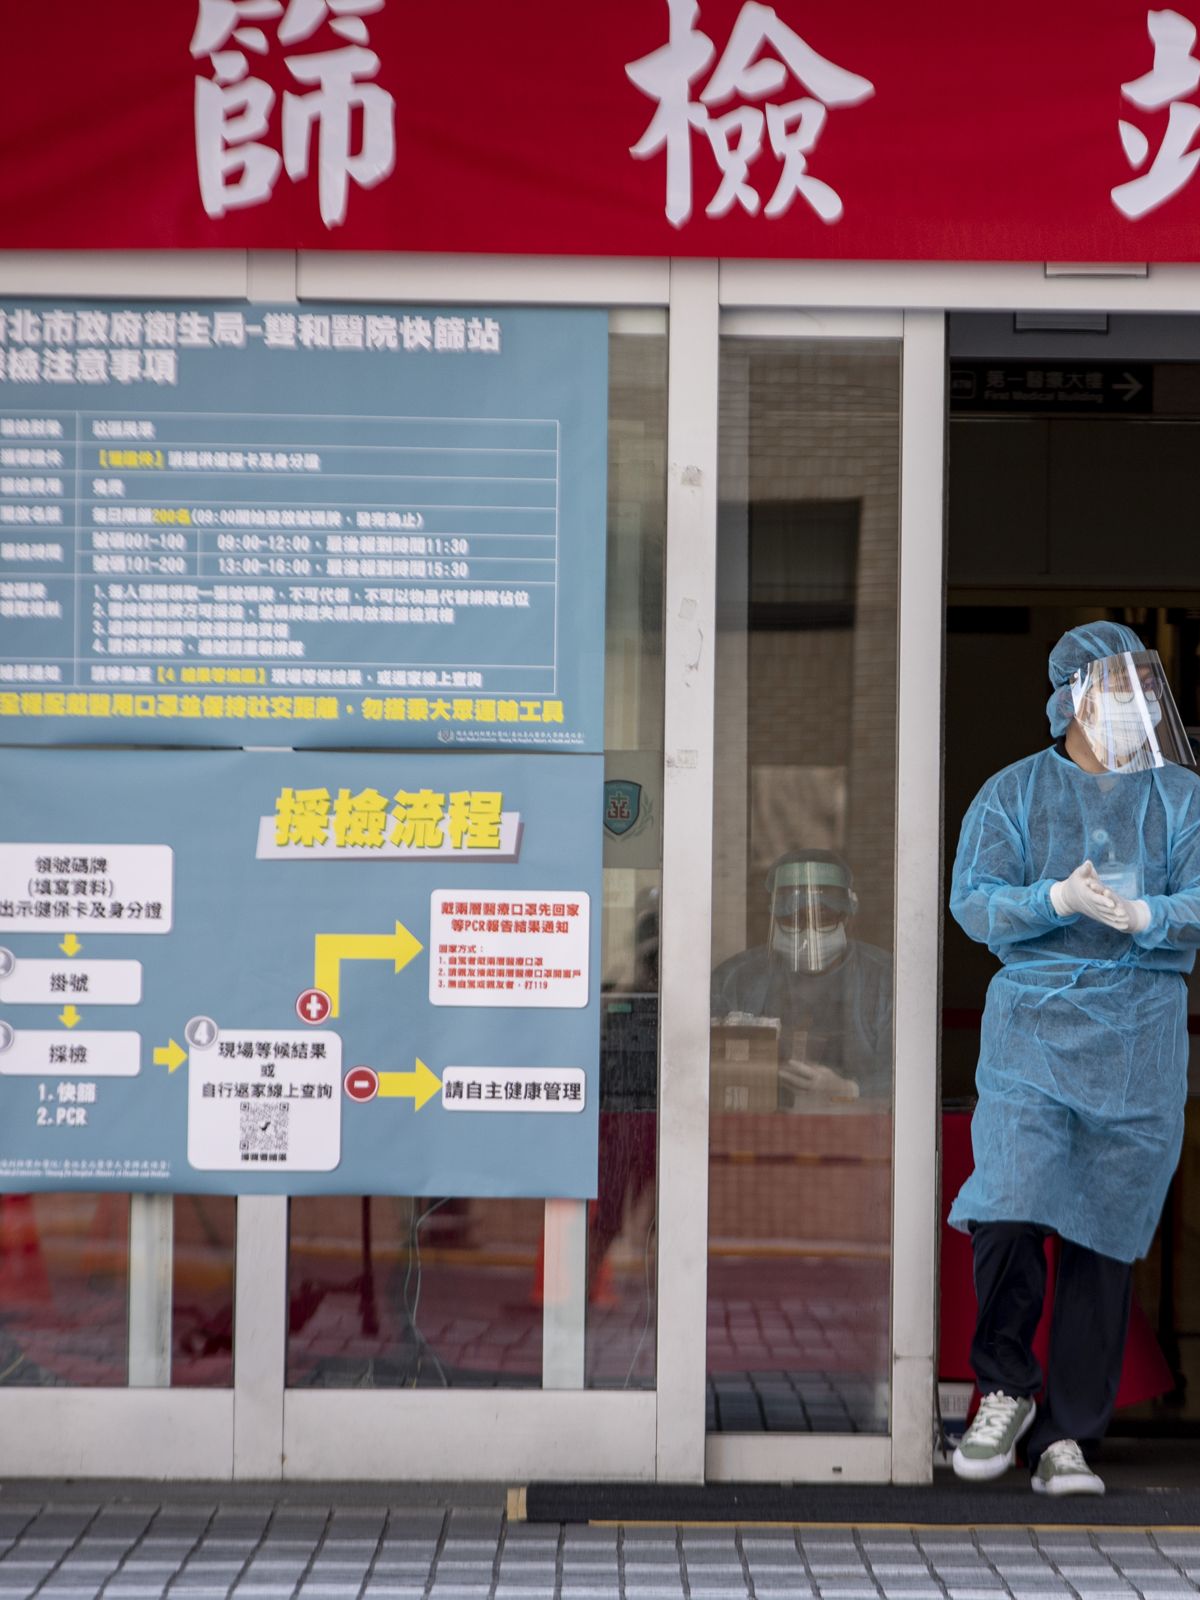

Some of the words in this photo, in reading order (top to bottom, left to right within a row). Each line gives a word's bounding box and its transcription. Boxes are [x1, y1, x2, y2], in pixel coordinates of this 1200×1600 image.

[0, 309, 500, 352] 北市政府衛生局-雙和醫院快篩站
[0, 348, 178, 385] 檢注意事項
[274, 787, 503, 849] 採檢流程
[35, 856, 107, 874] 領號碼牌
[28, 878, 114, 897] (填寫資料)
[50, 974, 89, 992] 掛號
[49, 1043, 88, 1063] 採檢
[218, 1041, 326, 1060] 現場等候結果
[202, 1082, 332, 1099] 自行返家線上查詢
[445, 1080, 581, 1101] 請自主健康管理
